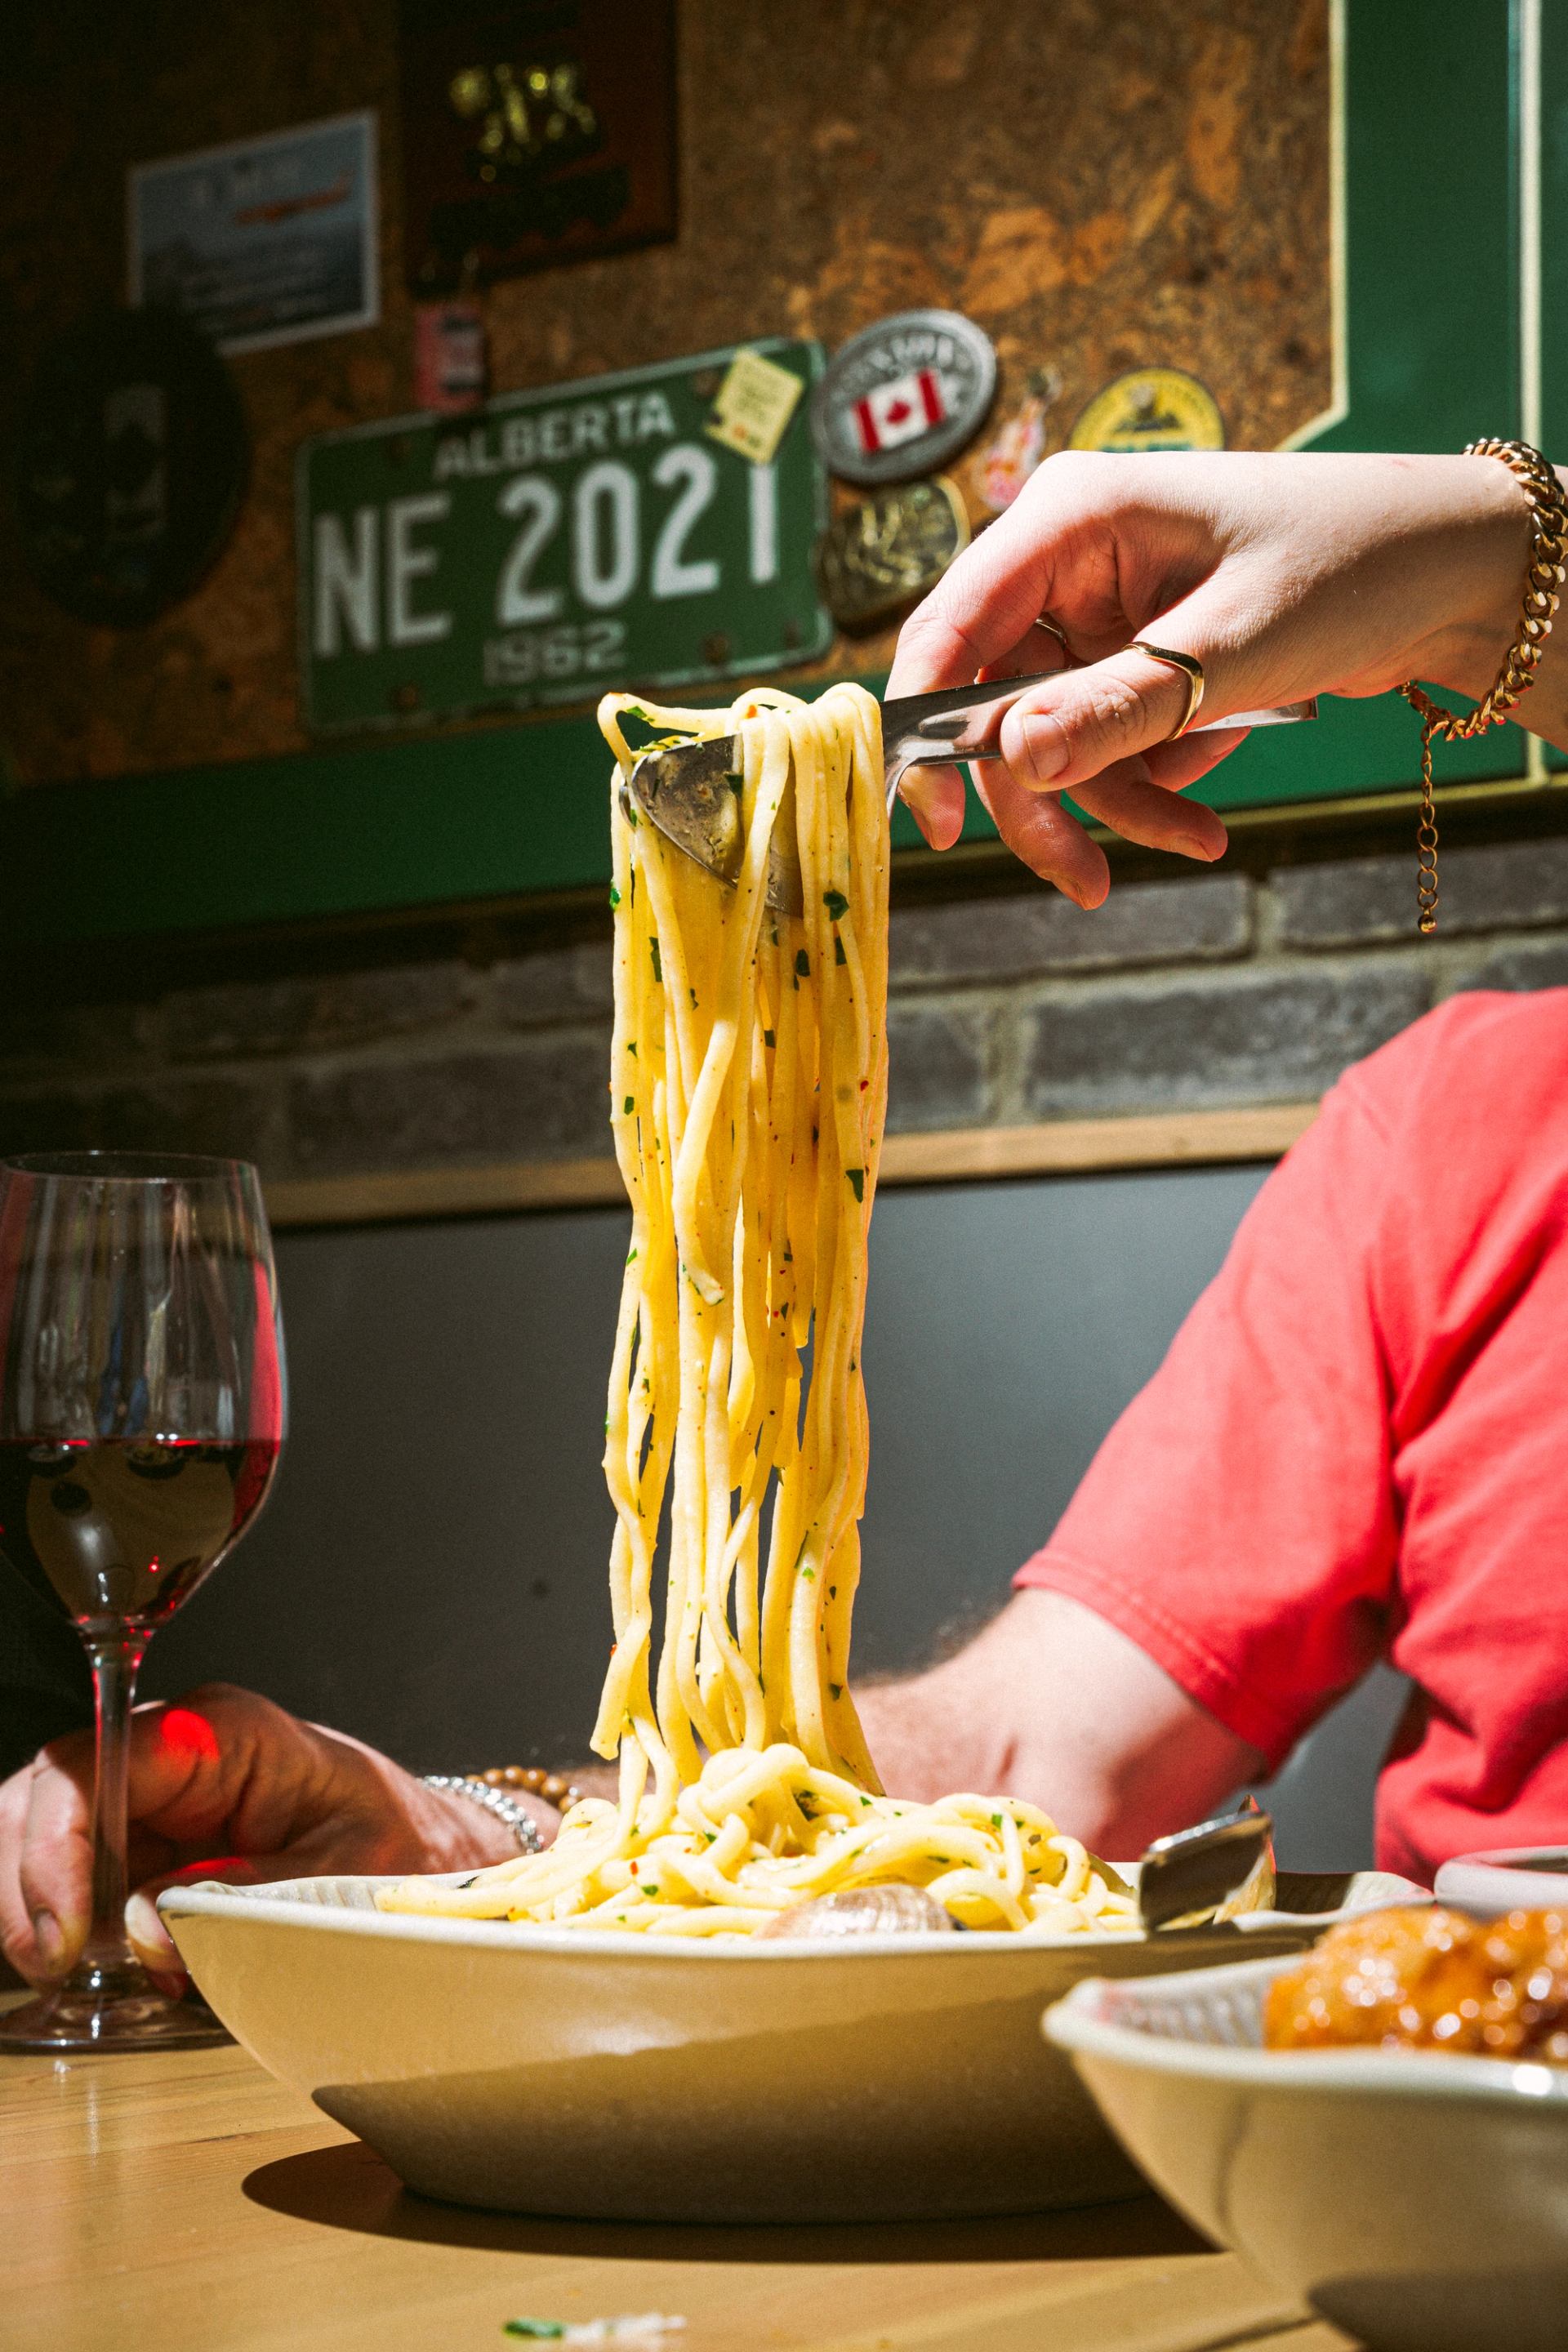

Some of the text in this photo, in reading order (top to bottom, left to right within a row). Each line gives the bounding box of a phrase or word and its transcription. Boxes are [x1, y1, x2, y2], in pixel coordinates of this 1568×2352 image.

[433, 392, 676, 481] ALBERTA
[313, 442, 778, 656] NE 2021
[485, 621, 627, 685] 1962
